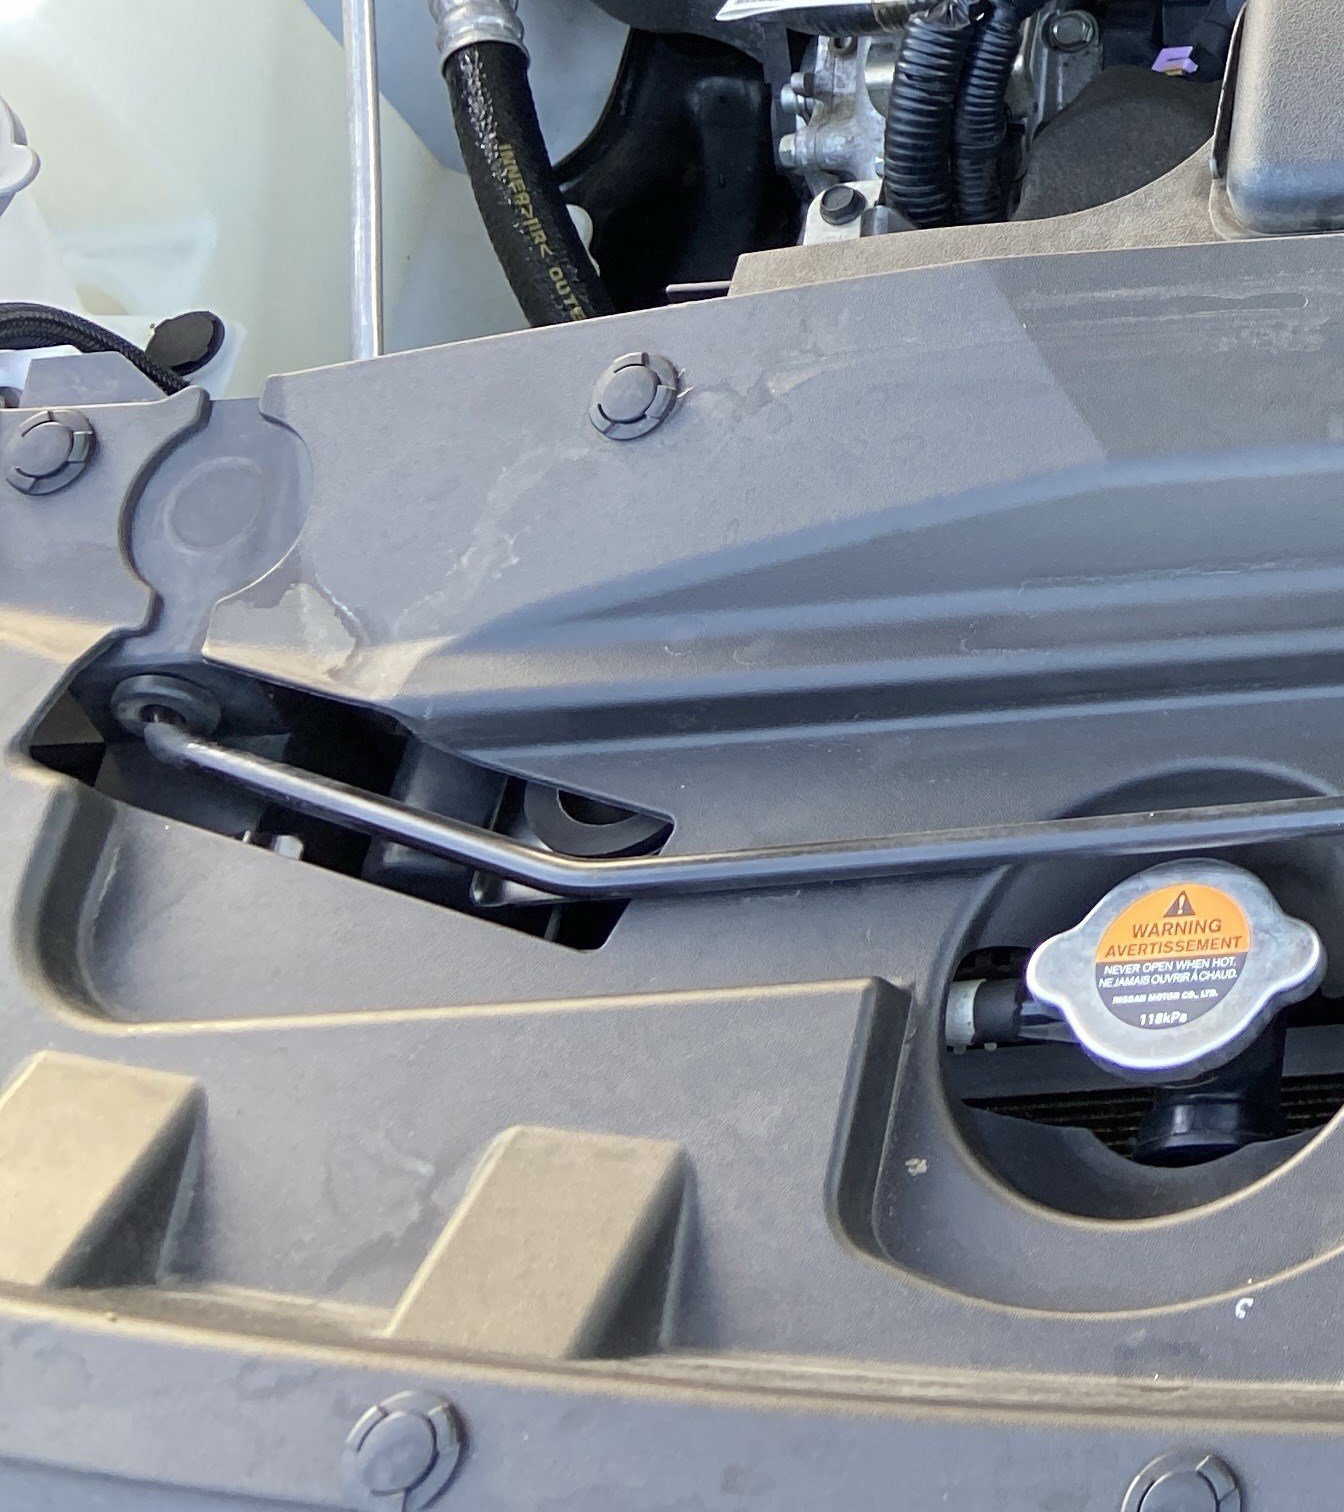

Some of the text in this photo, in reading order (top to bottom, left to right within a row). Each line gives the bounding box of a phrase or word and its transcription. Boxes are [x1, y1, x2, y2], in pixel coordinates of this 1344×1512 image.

[1132, 918, 1222, 939] WARNING
[1104, 935, 1244, 958] AVERTISSEMENT
[1103, 956, 1237, 975] NEVER OPEN WHEN HOT.
[1098, 977, 1114, 988] NE
[1114, 974, 1151, 987] JAMAIS
[1151, 972, 1190, 985] OUVRIR
[1199, 968, 1238, 981] CHAUD.
